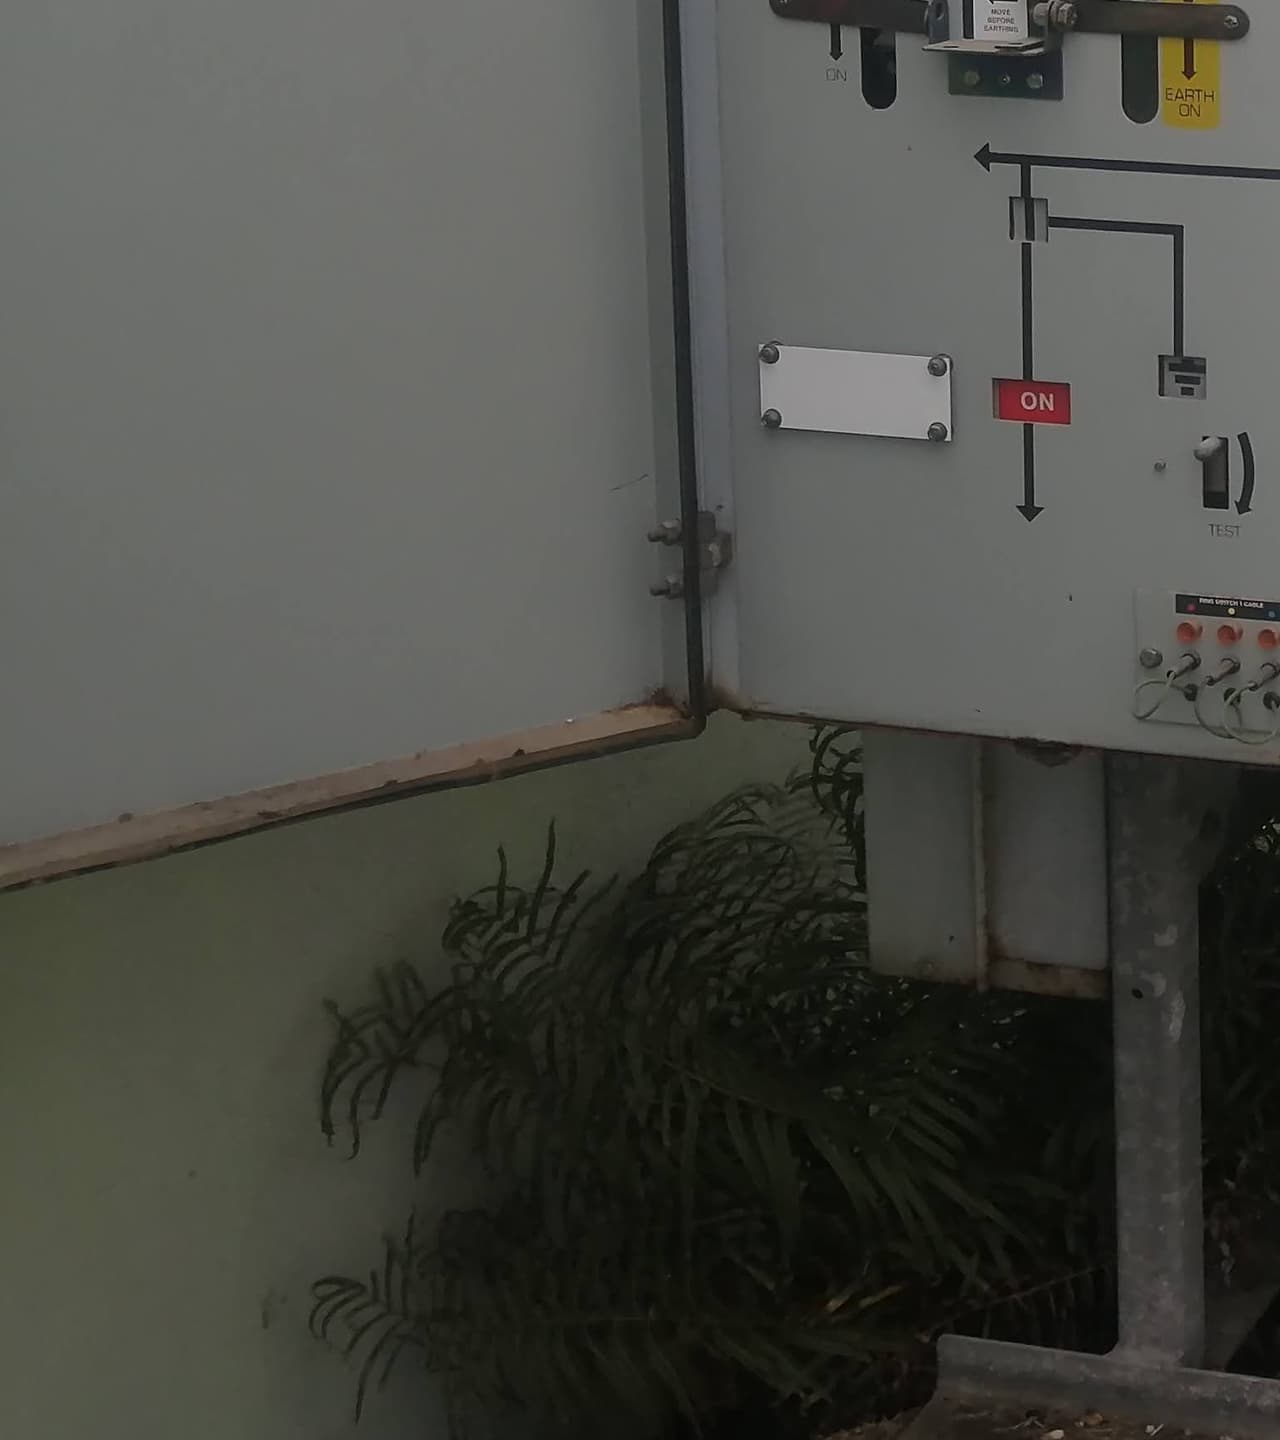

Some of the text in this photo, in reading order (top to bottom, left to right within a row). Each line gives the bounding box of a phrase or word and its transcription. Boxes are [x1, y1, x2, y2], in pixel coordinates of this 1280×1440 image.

[826, 69, 847, 82] ON
[1165, 88, 1215, 103] EARTH
[1178, 103, 1201, 118] ON
[1020, 392, 1054, 411] ON
[1208, 523, 1242, 538] TEST
